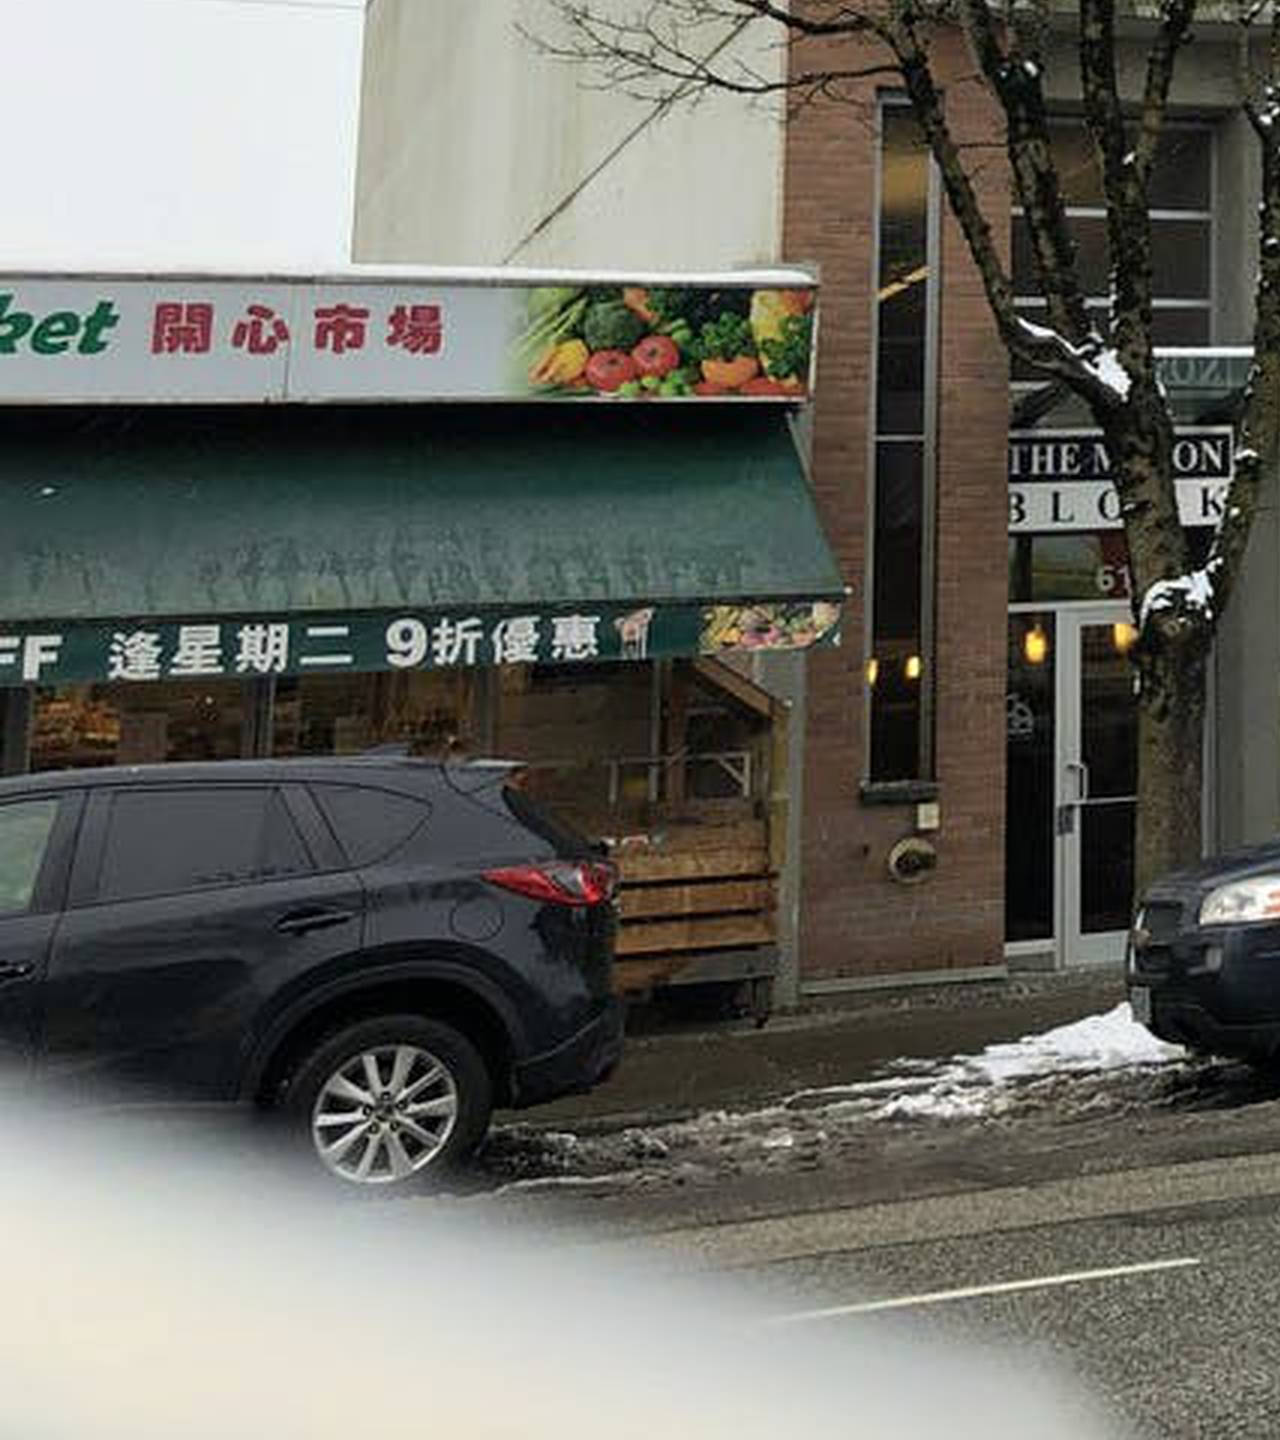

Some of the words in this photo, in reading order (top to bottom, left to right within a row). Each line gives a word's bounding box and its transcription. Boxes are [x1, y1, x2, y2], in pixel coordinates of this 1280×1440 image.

[152, 301, 442, 357] 開心市場
[1011, 443, 1082, 475] THE
[1008, 487, 1225, 524] BLOK
[109, 622, 353, 680] 逢星期二
[385, 615, 600, 666] 9折優惠
